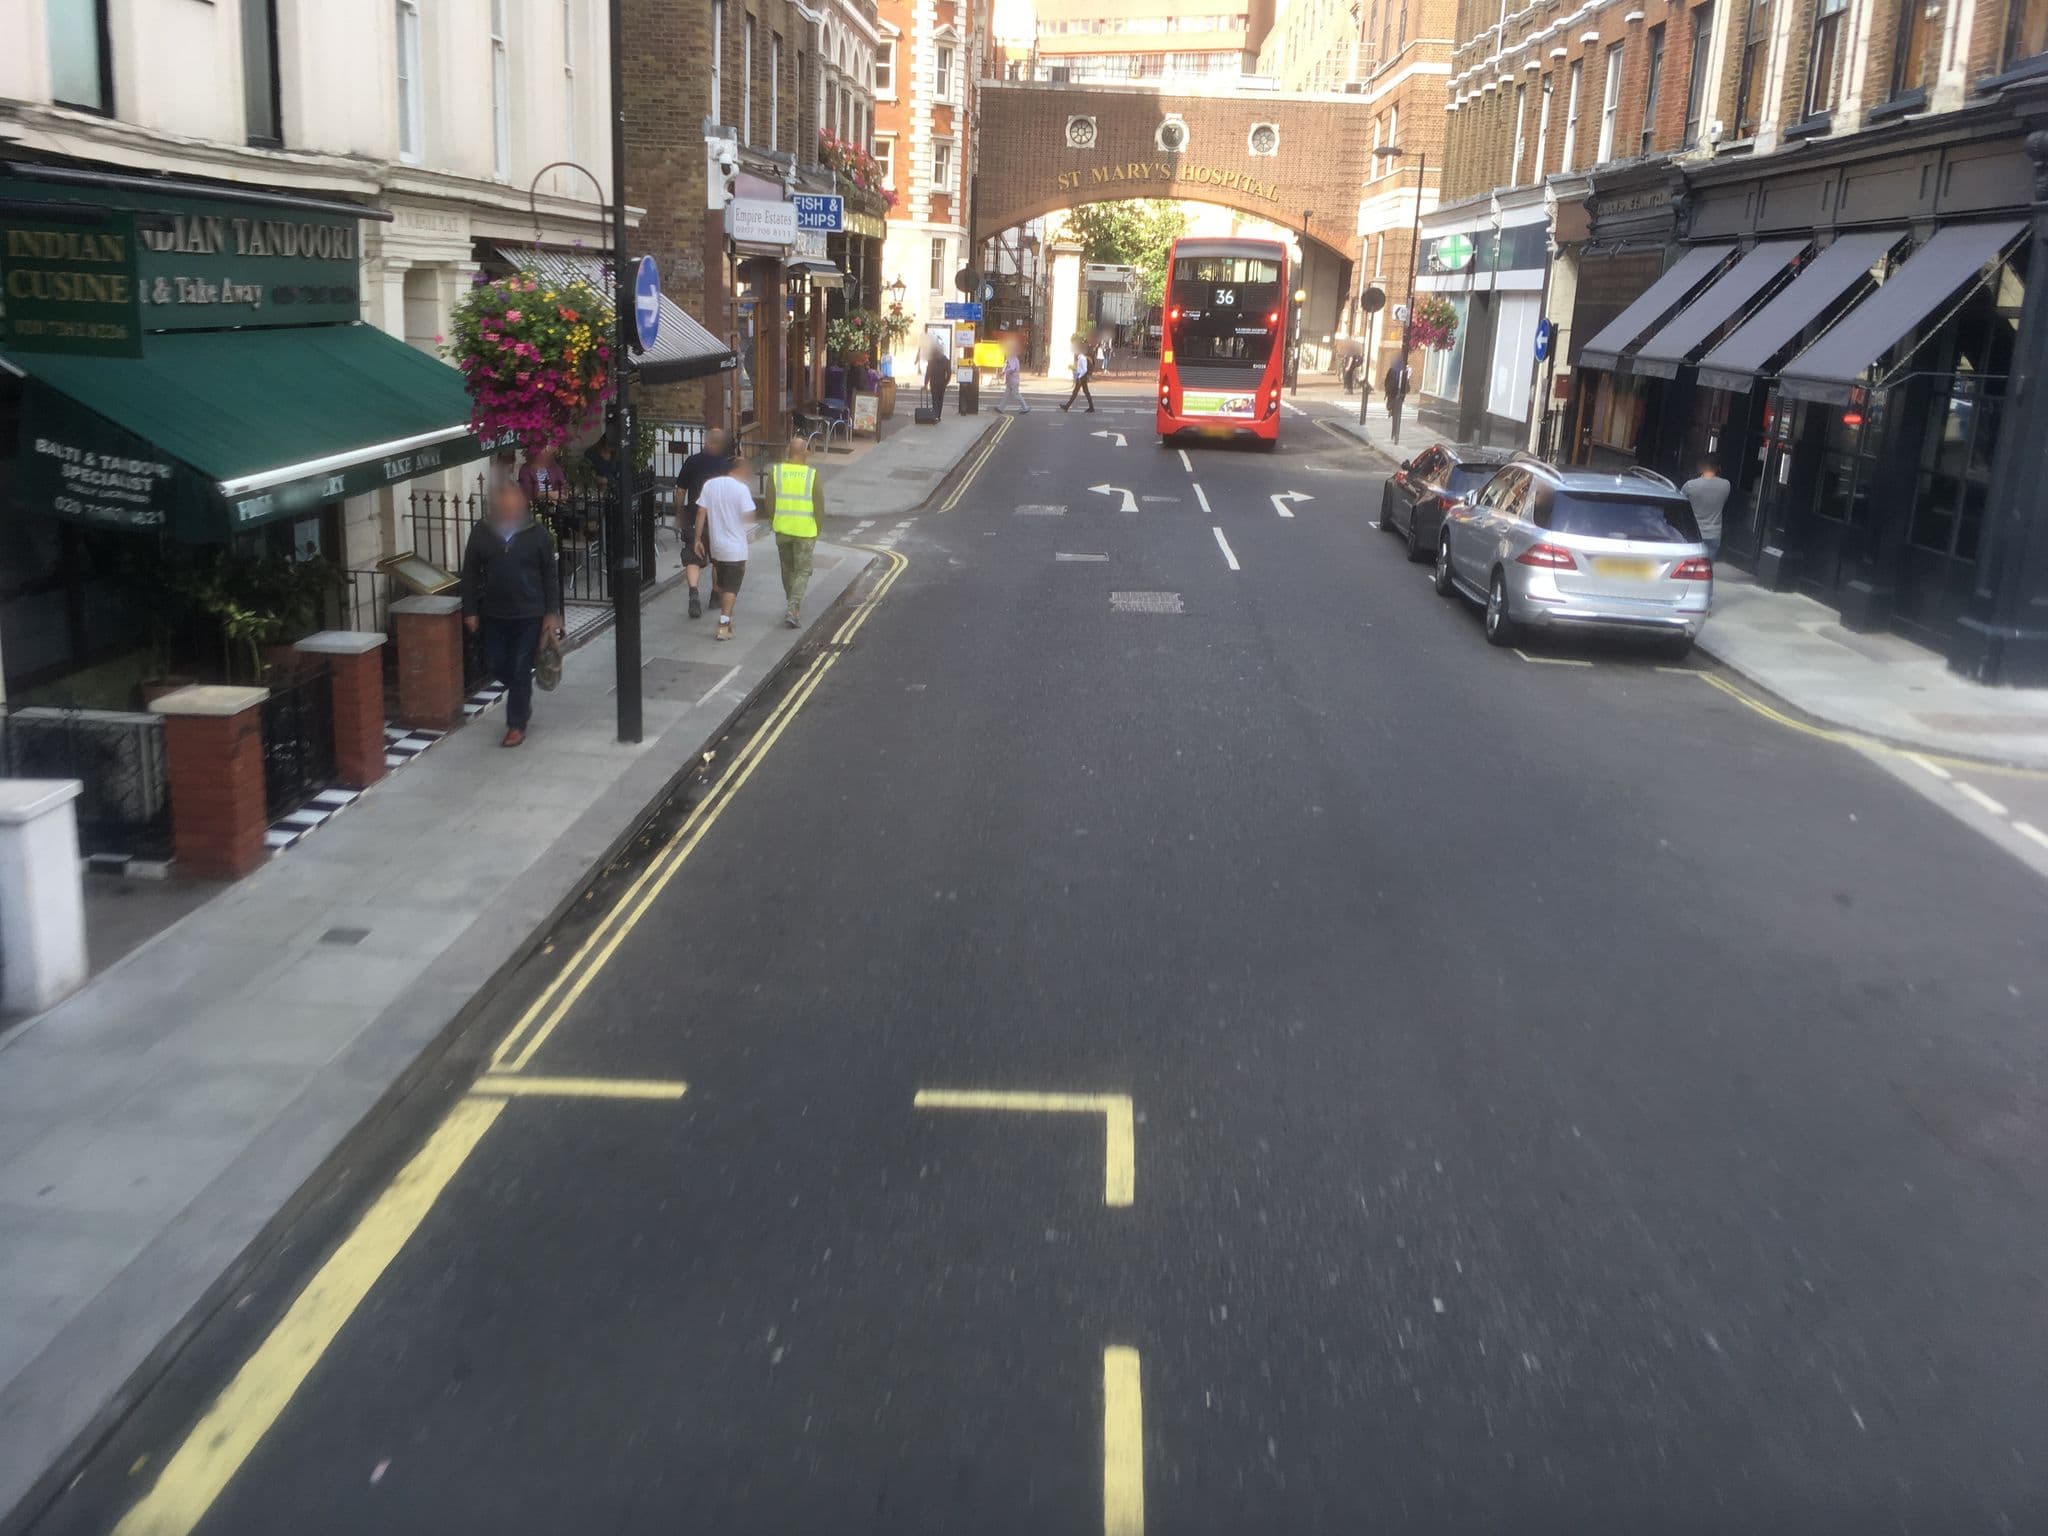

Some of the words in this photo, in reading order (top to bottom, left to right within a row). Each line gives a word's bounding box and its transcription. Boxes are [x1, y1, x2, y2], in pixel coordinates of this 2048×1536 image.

[1057, 170, 1082, 191] ST
[1090, 162, 1171, 184] MARY'S
[1179, 164, 1280, 203] HOSPITAL
[735, 207, 762, 226] Empire
[765, 209, 793, 226] Estates
[793, 196, 823, 211] FISH
[829, 198, 839, 212] &
[798, 212, 836, 228] CHIPS
[6, 230, 126, 262] INDIAN
[232, 218, 353, 260] TANDOORI
[8, 269, 129, 304] CUSINE
[152, 276, 172, 304] &
[174, 276, 219, 304] Take
[221, 277, 263, 309] Away
[1216, 289, 1235, 305] 36
[35, 438, 81, 462] BALTI
[84, 452, 97, 466] &
[61, 462, 153, 491] SPECIALIST
[383, 459, 413, 480] TAKE
